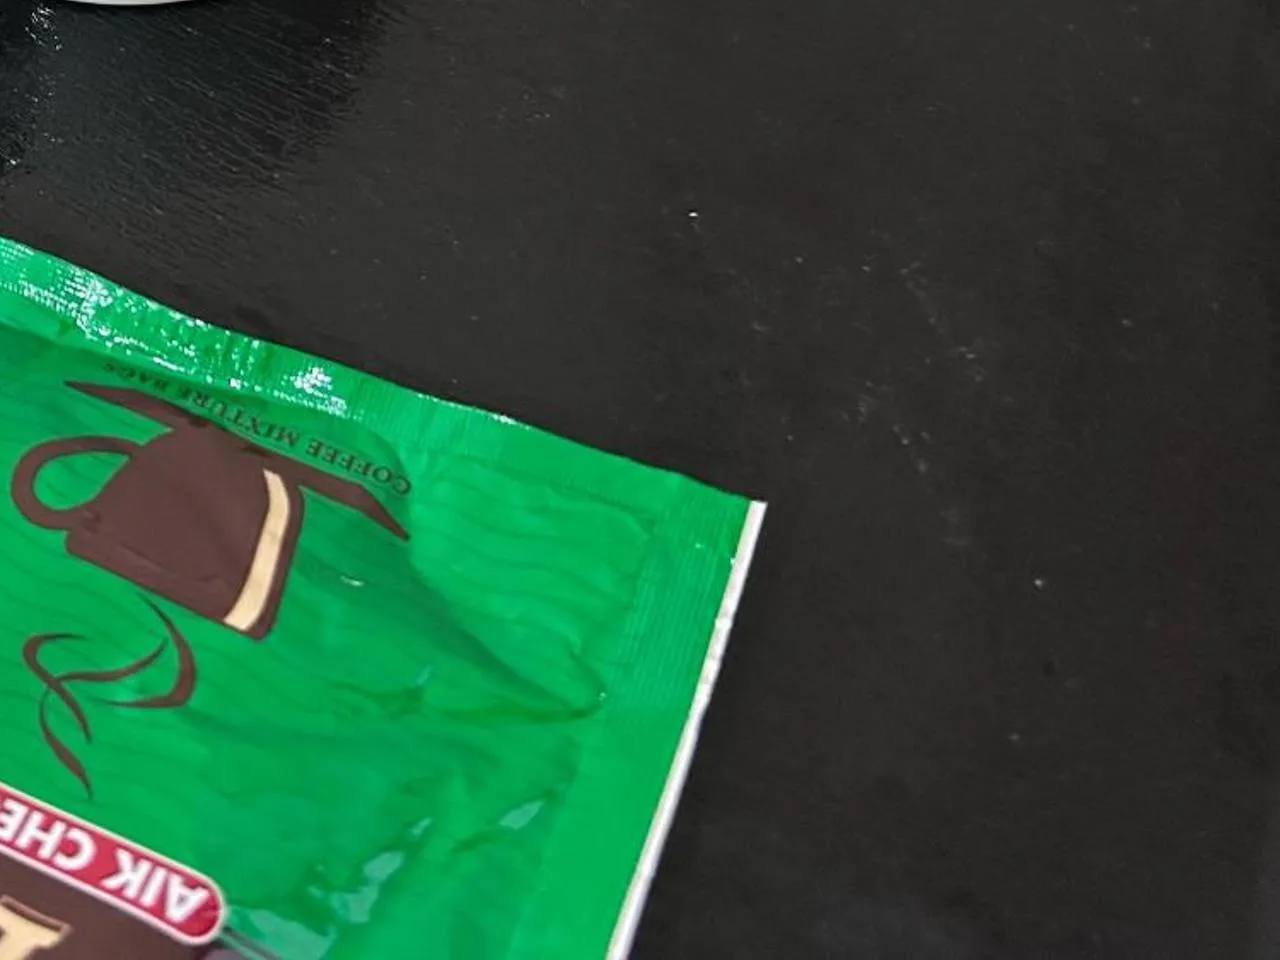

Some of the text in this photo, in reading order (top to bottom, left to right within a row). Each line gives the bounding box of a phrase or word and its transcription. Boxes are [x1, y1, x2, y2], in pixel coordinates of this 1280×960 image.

[177, 387, 299, 448] MIXTURE
[306, 438, 412, 496] COFFEE
[104, 851, 208, 924] AIK
